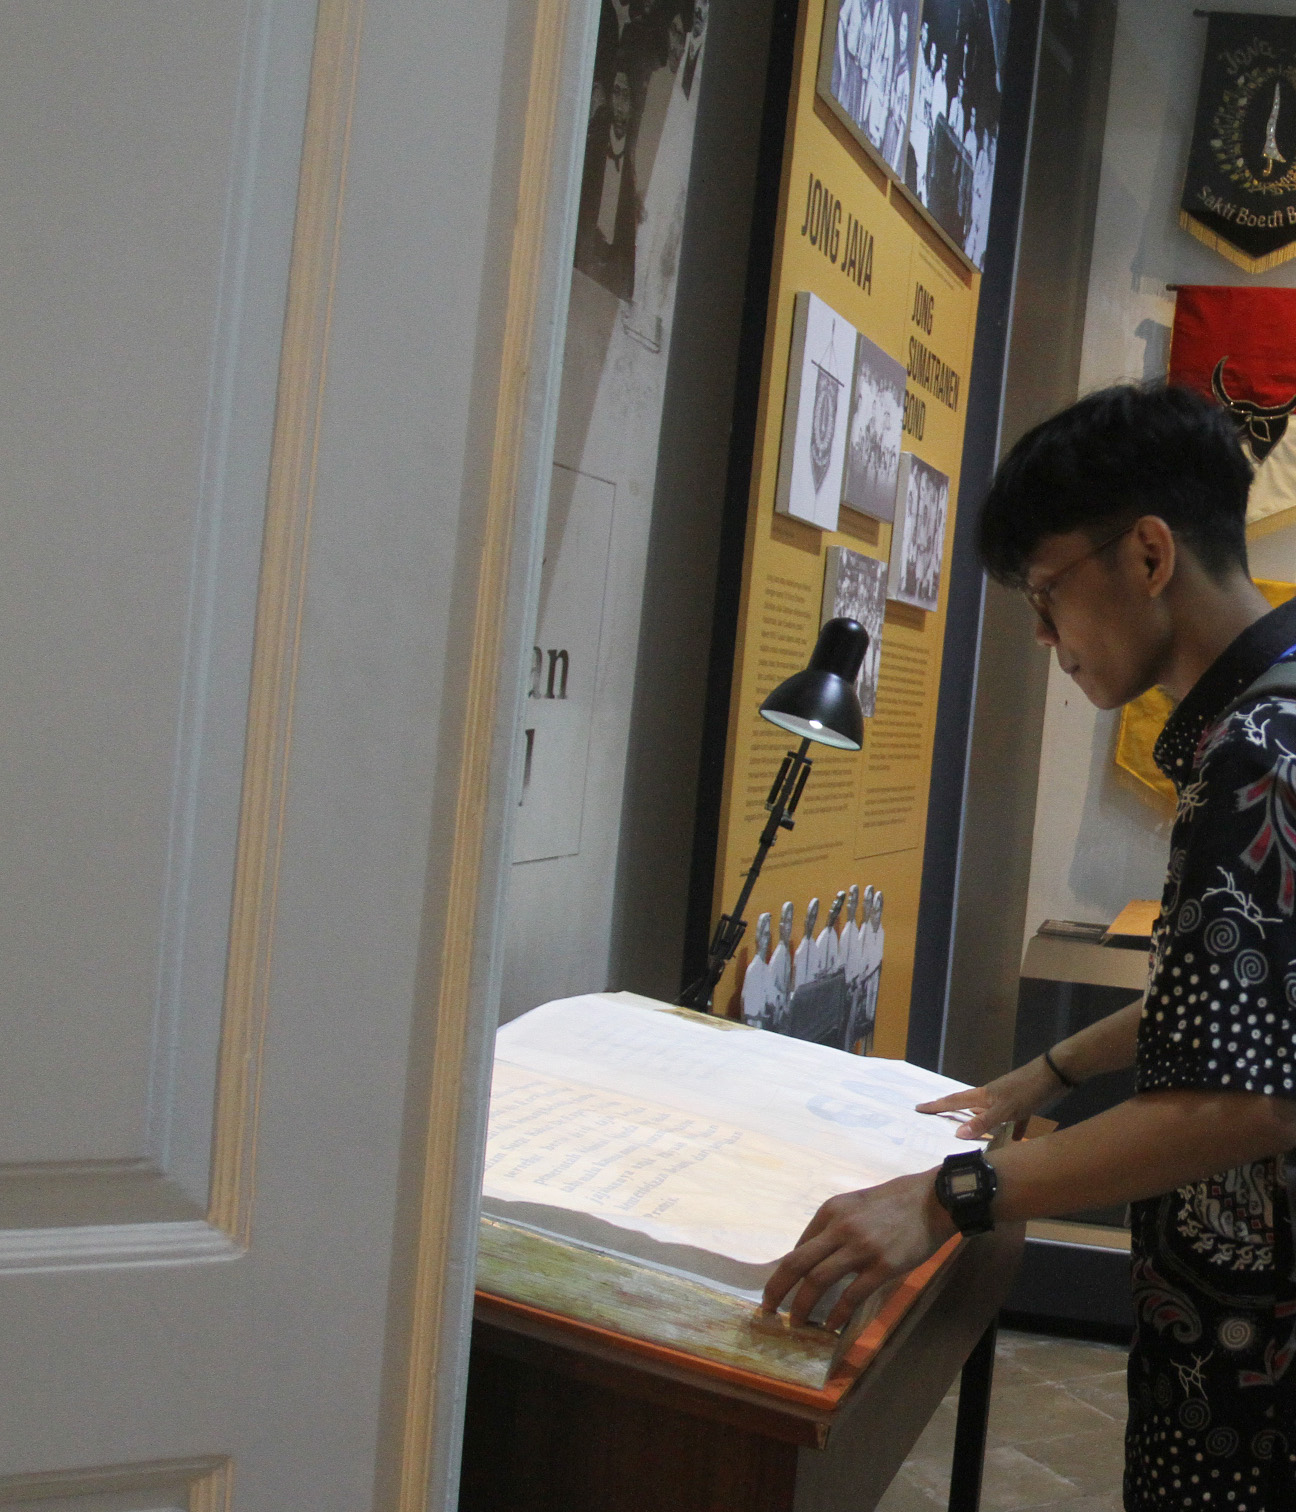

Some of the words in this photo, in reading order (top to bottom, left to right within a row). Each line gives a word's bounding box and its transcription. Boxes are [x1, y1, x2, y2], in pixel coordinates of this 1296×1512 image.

[1198, 185, 1237, 220] Sakti
[801, 172, 842, 265] JONG
[840, 212, 875, 297] JAVA
[911, 280, 935, 336] JONG
[906, 335, 961, 413] SUMATRANEN
[901, 389, 926, 442] BOND
